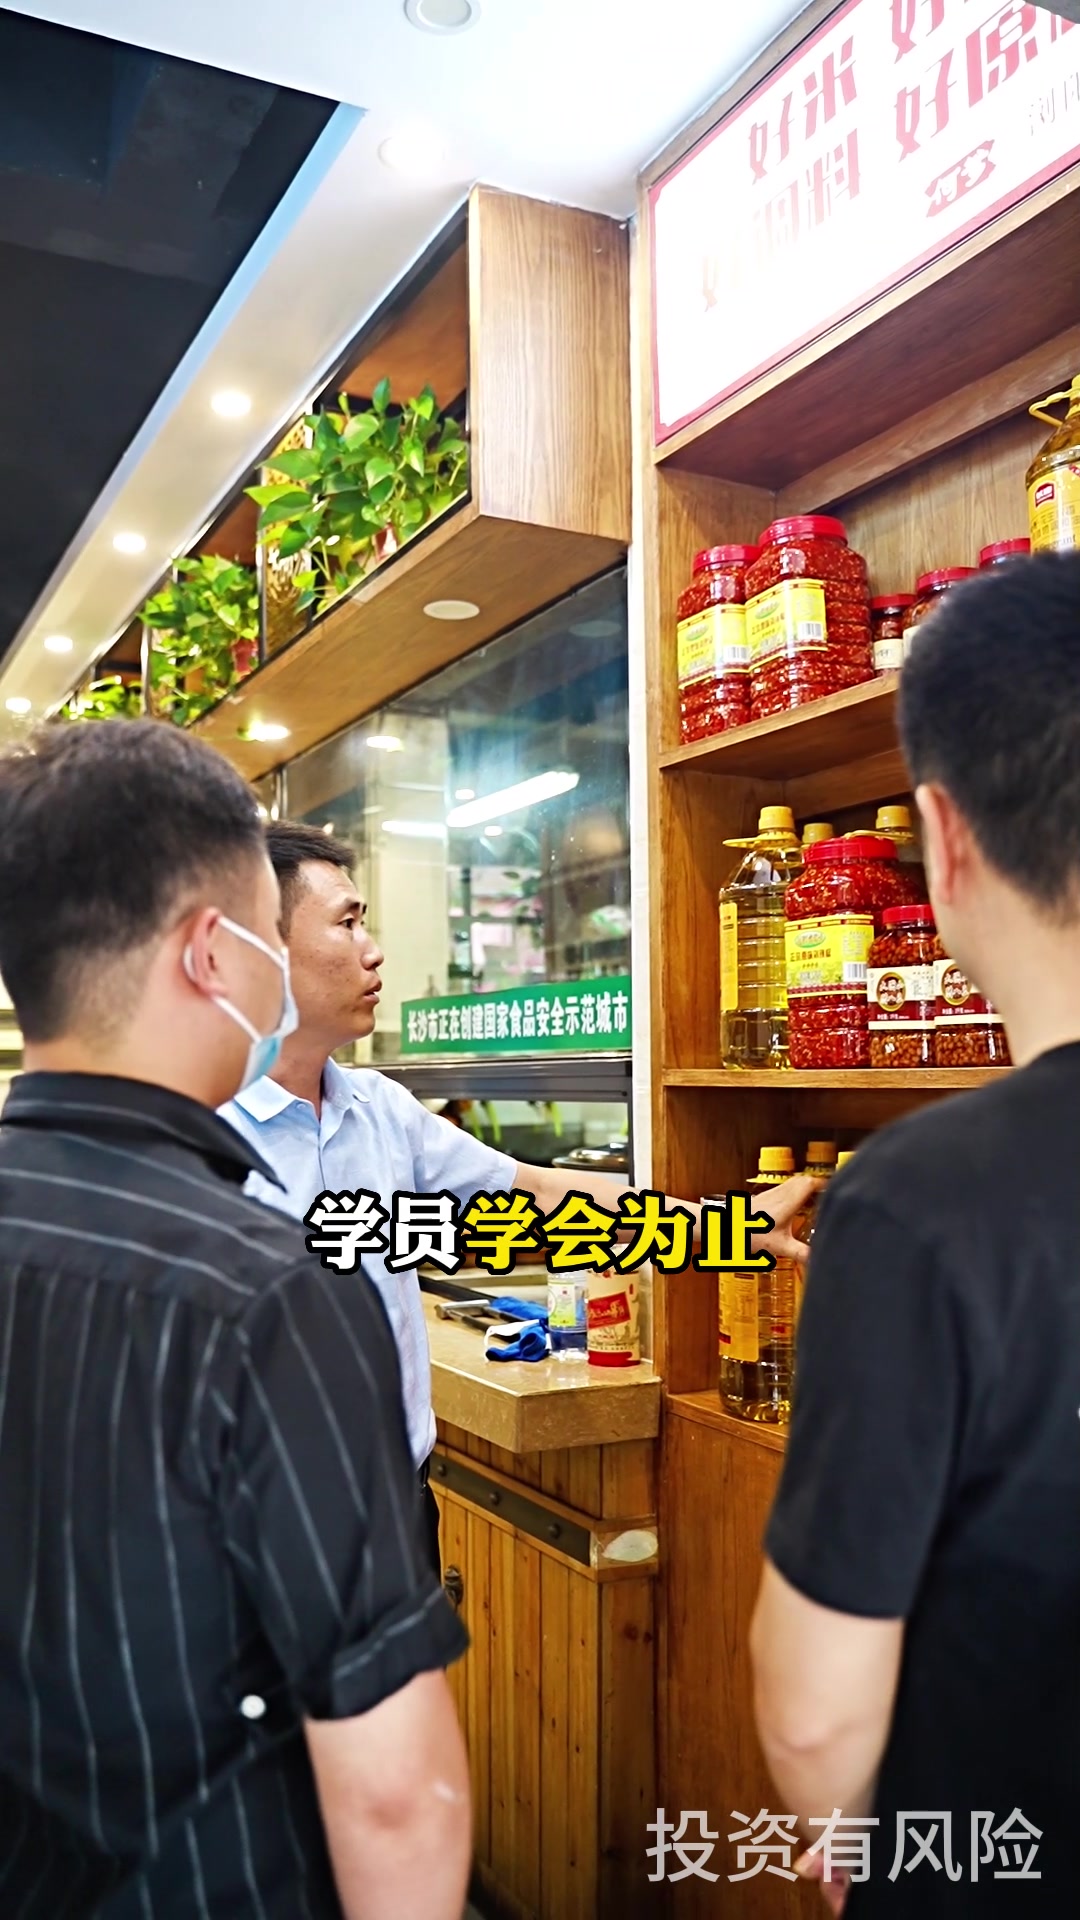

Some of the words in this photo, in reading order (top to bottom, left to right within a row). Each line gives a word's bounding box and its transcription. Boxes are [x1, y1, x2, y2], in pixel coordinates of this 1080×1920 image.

[747, 34, 858, 185] 好米
[407, 990, 628, 1043] 长沙市正在创建国家食品安全示范城市
